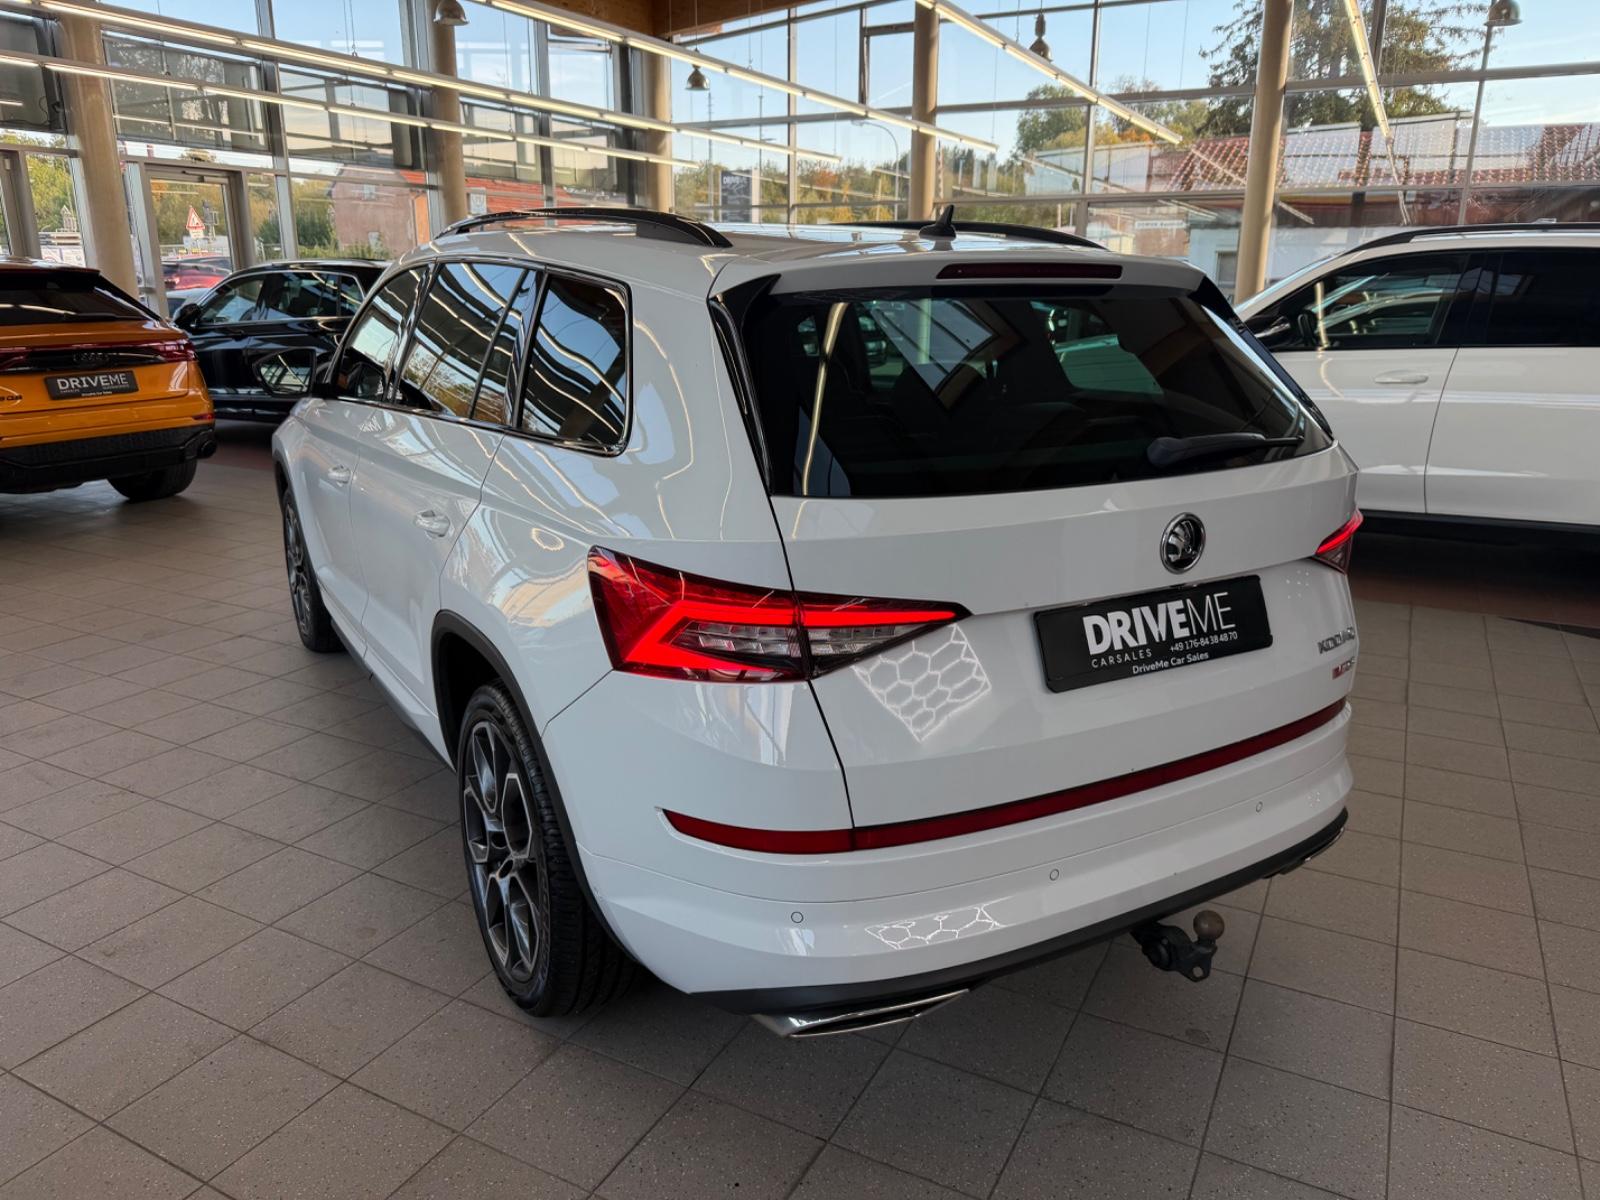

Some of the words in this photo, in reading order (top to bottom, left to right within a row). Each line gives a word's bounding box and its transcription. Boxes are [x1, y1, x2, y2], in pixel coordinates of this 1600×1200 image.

[57, 373, 128, 390] DRIVEME
[1082, 592, 1236, 655] DRIVEME
[1170, 641, 1184, 652] +49
[1091, 648, 1152, 668] CARSALES
[1132, 659, 1169, 675] DriveMe
[1170, 656, 1185, 667] Car
[1186, 652, 1209, 663] Sales
